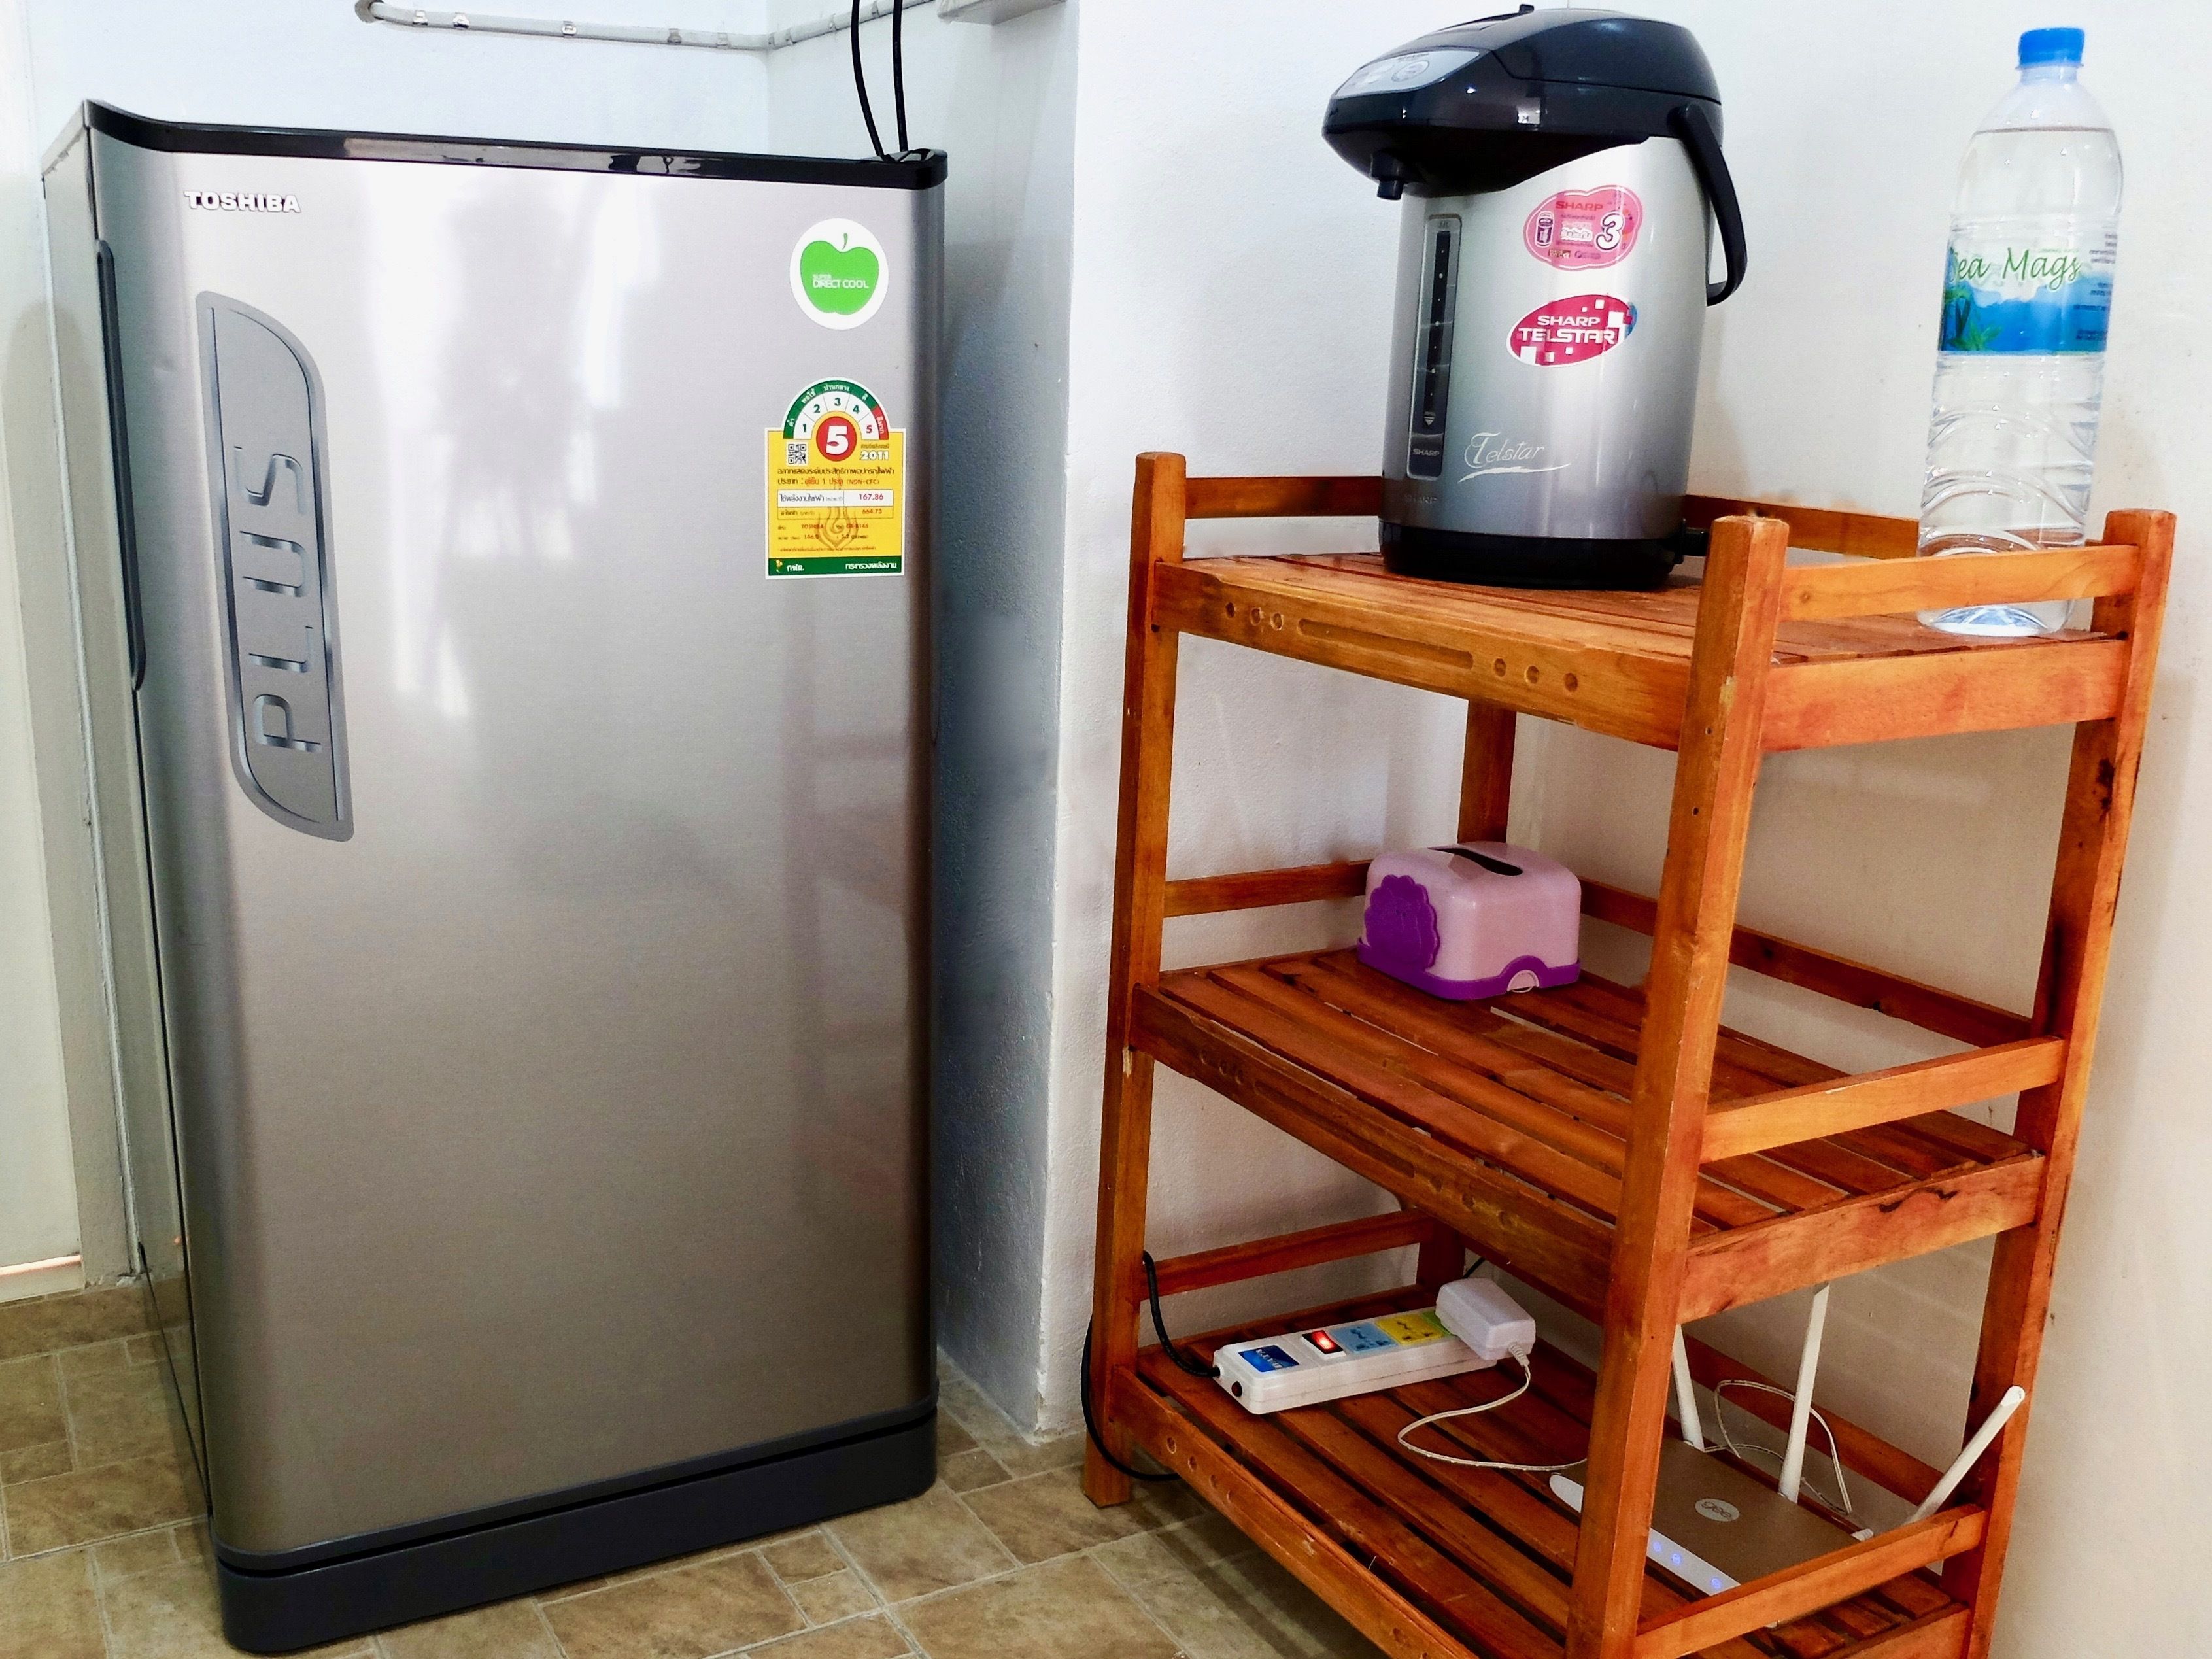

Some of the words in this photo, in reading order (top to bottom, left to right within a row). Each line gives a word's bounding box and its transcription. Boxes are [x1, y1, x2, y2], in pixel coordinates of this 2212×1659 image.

[184, 190, 301, 213] TOSHIBA
[1556, 201, 1603, 211] SHARP
[1596, 213, 1624, 250] 3
[2002, 247, 2082, 290] Mags
[813, 279, 841, 288] DIRECT
[843, 279, 870, 288] COOL
[1537, 315, 1601, 326] SHARP
[1518, 328, 1615, 344] TELSTAR
[834, 398, 841, 406] 3
[813, 403, 821, 413] 2
[853, 405, 860, 414] 4
[802, 424, 807, 433] 1
[866, 424, 872, 434] 5
[825, 425, 849, 454] 5
[860, 451, 889, 460] 2011
[1464, 432, 1544, 469] Telstar
[233, 445, 322, 752] PLUS
